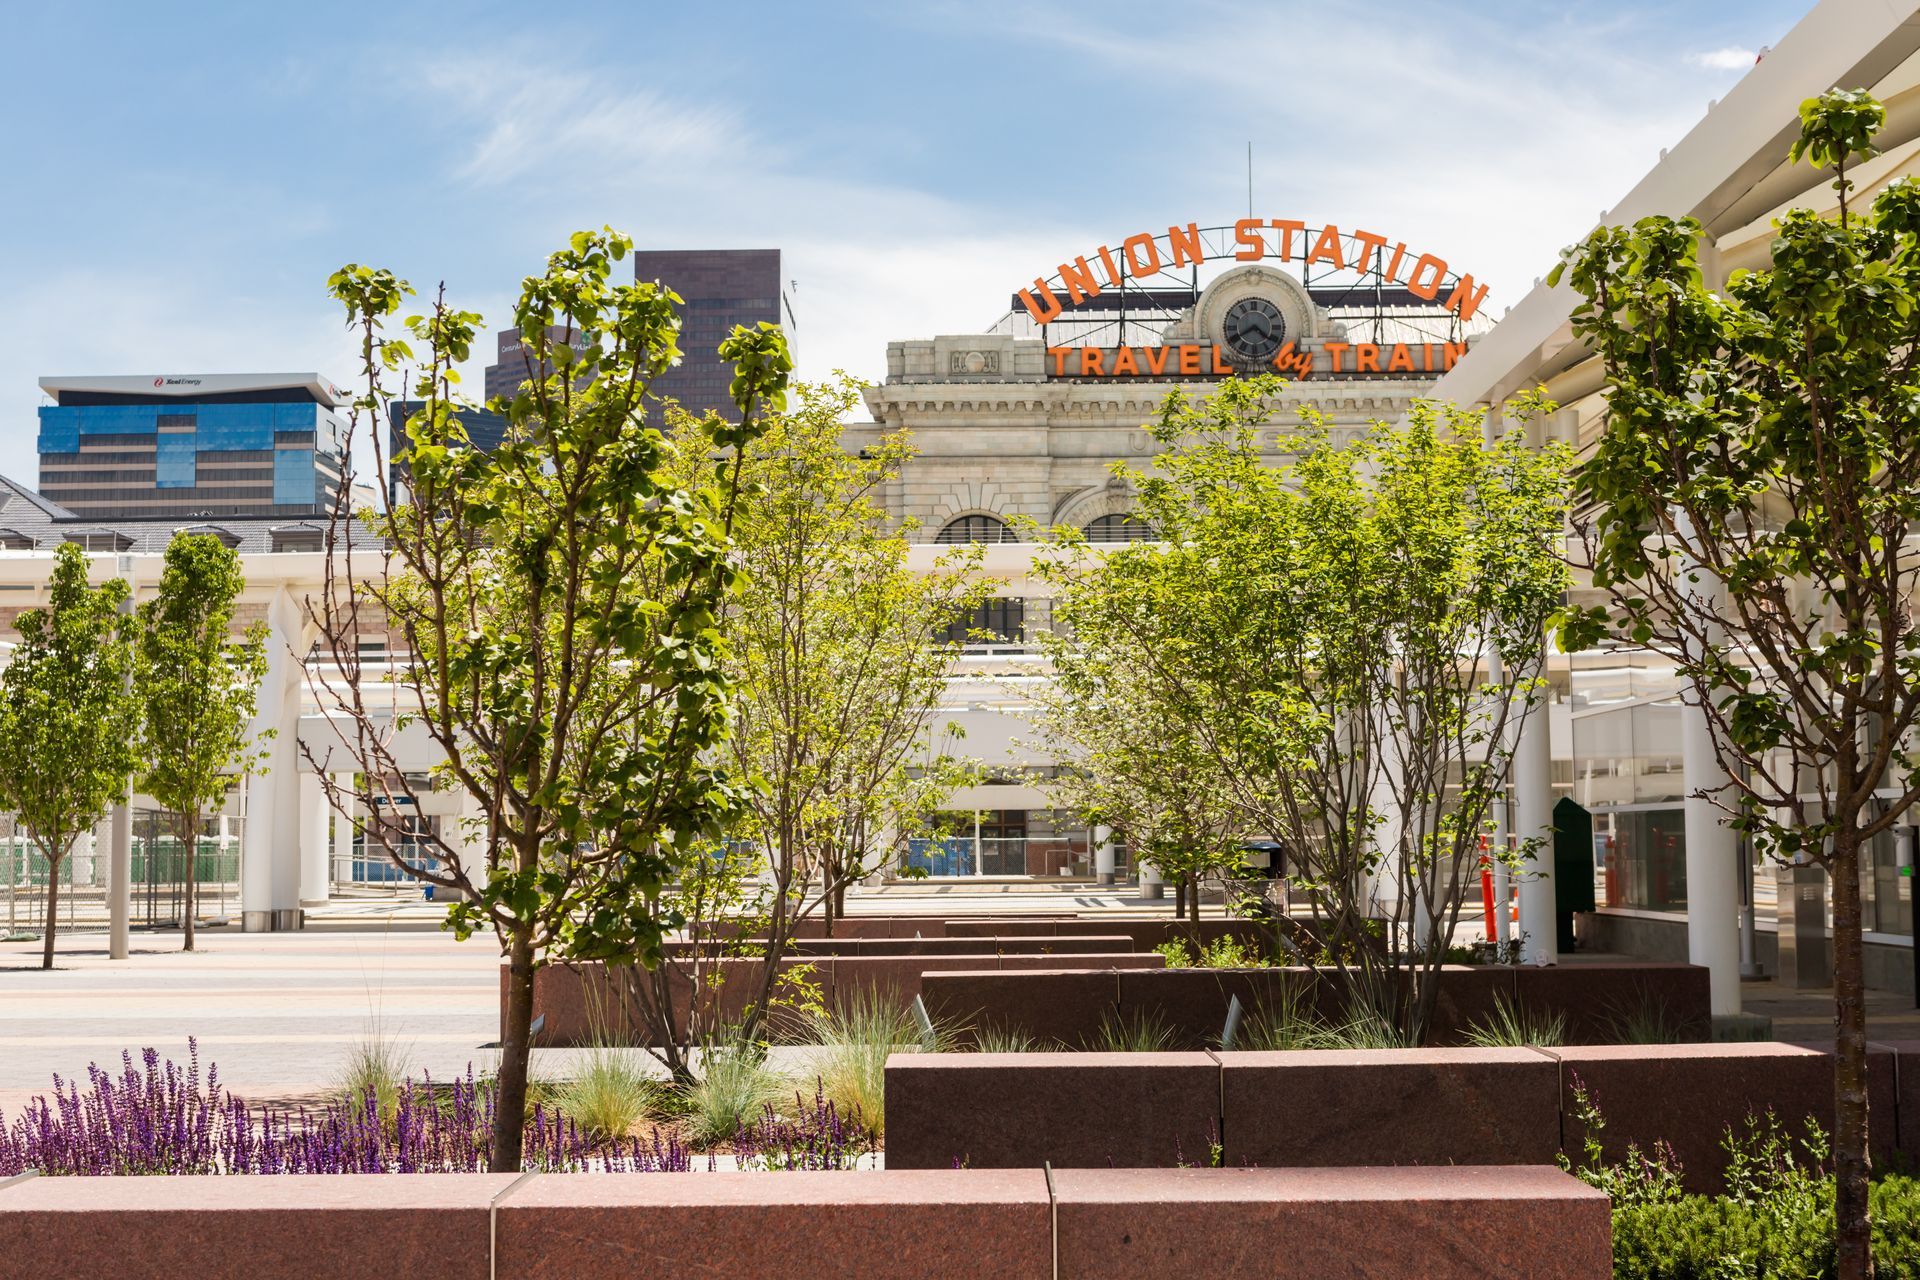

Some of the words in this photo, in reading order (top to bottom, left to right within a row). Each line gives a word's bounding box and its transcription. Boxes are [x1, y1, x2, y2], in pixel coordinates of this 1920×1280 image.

[1018, 223, 1204, 325] UNION
[1235, 219, 1489, 322] STATION
[1047, 343, 1234, 376] TRAVEL
[1272, 340, 1314, 381] by
[1323, 341, 1467, 373] TRAIN
